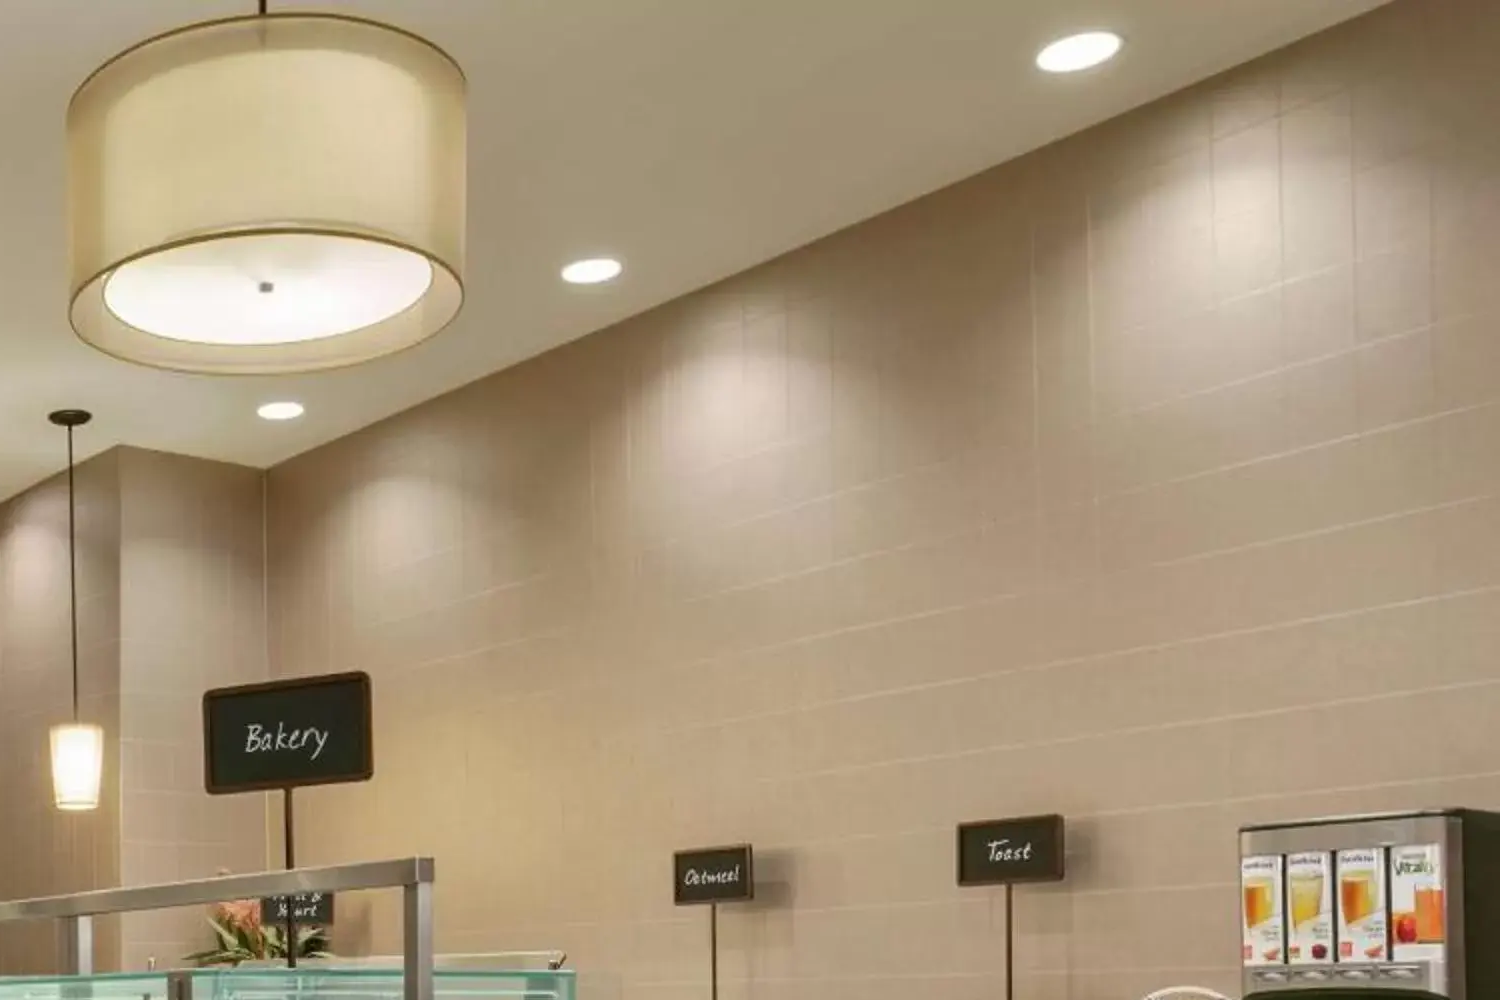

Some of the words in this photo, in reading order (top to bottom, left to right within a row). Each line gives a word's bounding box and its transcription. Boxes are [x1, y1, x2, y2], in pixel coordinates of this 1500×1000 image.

[245, 721, 329, 760] Bakery
[987, 839, 1032, 862] Toast
[684, 863, 740, 885] Oatmeal
[276, 903, 318, 917] Yourt
